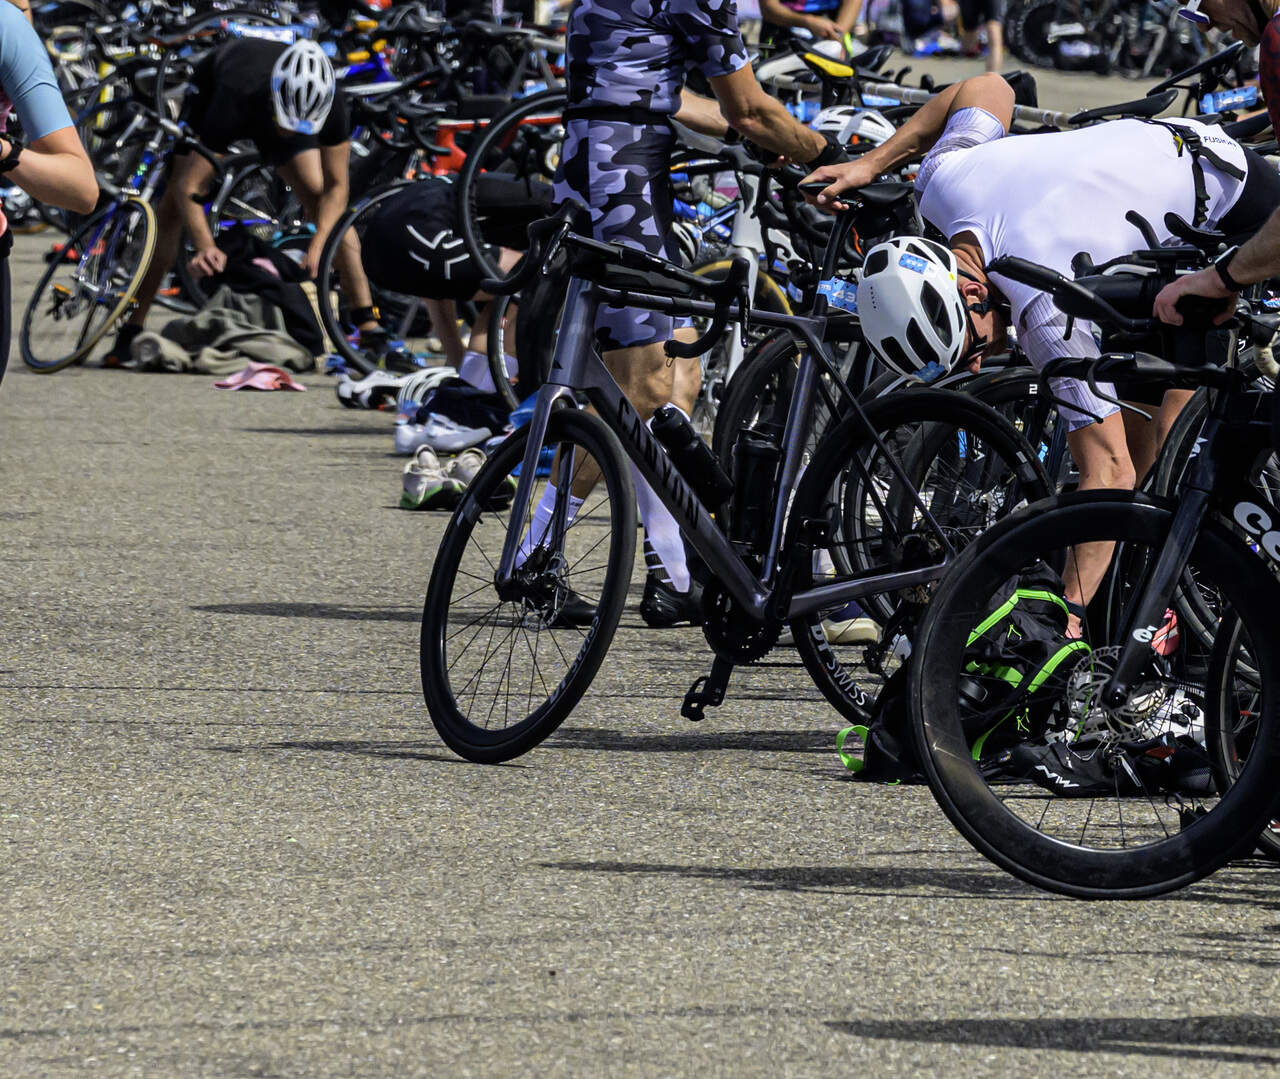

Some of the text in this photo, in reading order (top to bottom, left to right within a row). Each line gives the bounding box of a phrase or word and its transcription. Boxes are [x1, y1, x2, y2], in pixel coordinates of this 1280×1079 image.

[617, 395, 703, 528] CANYON
[810, 624, 869, 707] DT SWISS
